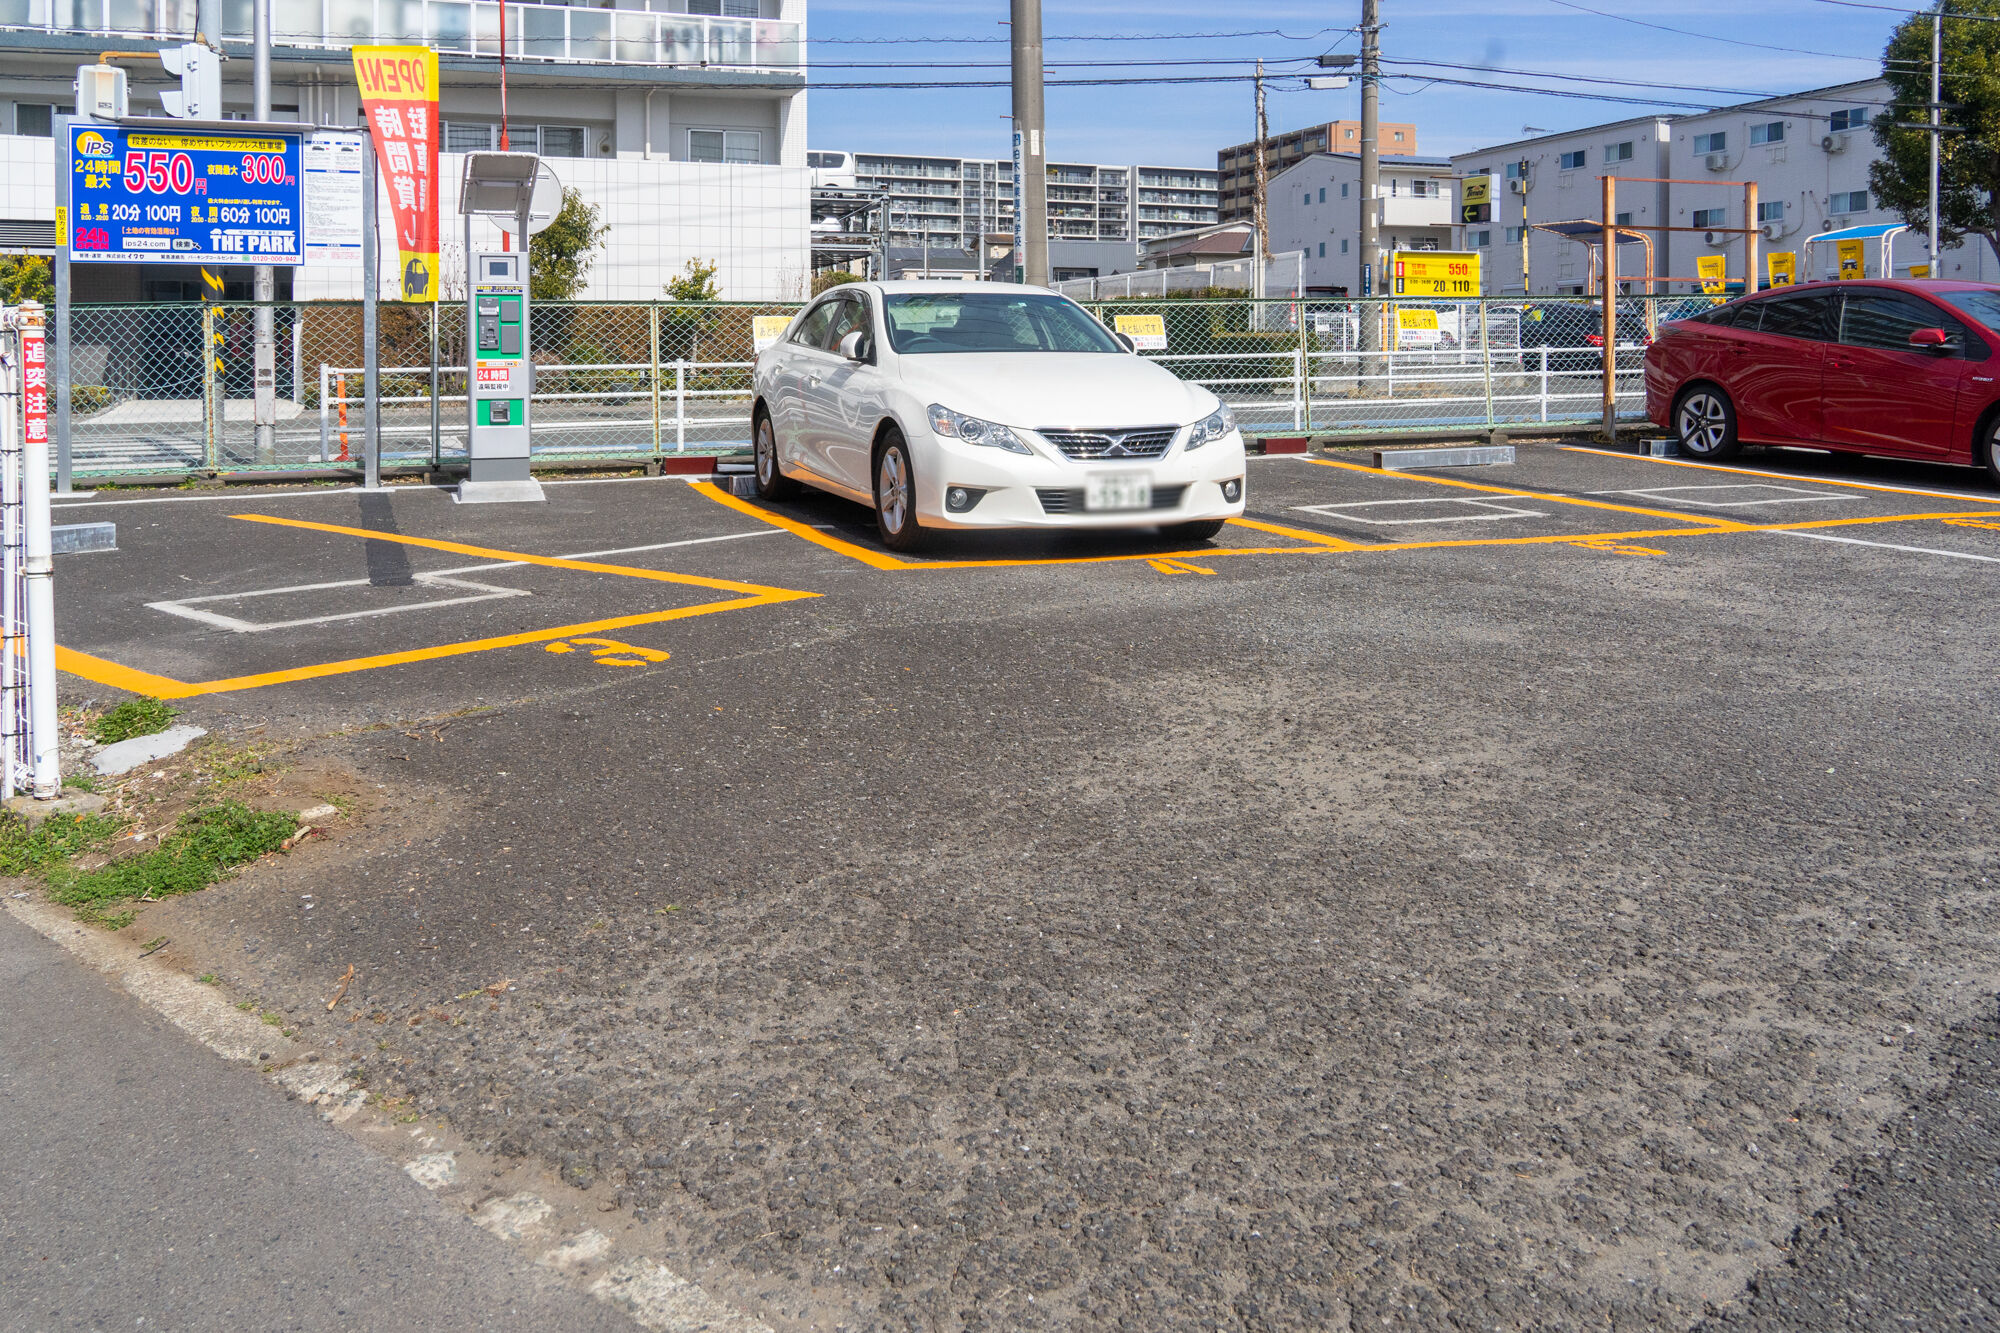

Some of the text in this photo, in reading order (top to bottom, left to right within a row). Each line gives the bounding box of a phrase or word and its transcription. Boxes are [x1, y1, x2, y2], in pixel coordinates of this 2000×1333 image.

[75, 160, 121, 174] 24時間
[207, 164, 239, 176] 夜間最大
[85, 174, 111, 188] 最大
[112, 204, 141, 221] 20分
[145, 205, 181, 222] 100円
[221, 207, 251, 224] 60分
[254, 207, 290, 224] 100円
[76, 227, 109, 242] 24h
[76, 242, 109, 250] OPEN
[125, 240, 166, 249] ips24.com
[210, 235, 296, 253] THE PARK
[25, 341, 48, 440] 追突注意
[545, 638, 671, 667] 3
